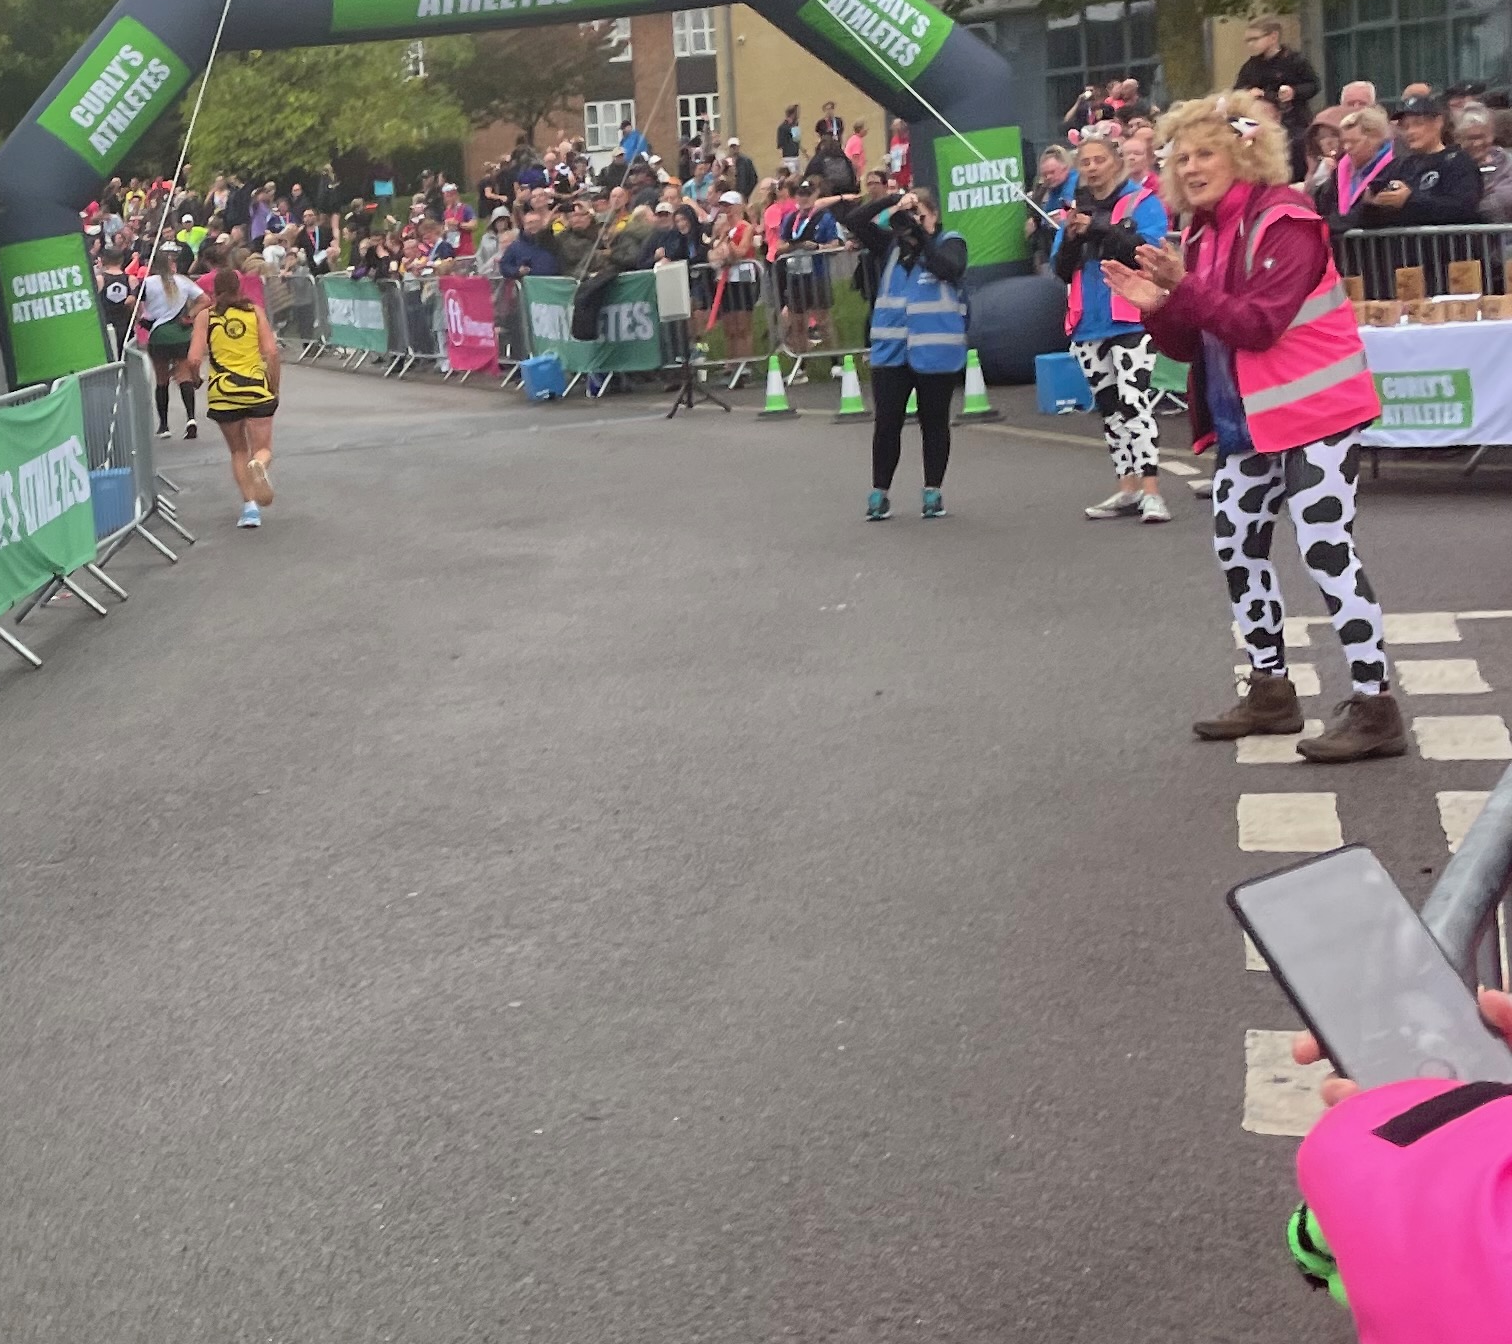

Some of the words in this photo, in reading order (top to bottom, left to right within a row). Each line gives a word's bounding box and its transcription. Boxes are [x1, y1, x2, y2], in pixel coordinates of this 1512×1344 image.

[70, 44, 144, 128] CURLY'S
[88, 57, 171, 156] ATHLETES
[11, 288, 92, 324] ATHLETES
[12, 264, 83, 298] CURLY'S
